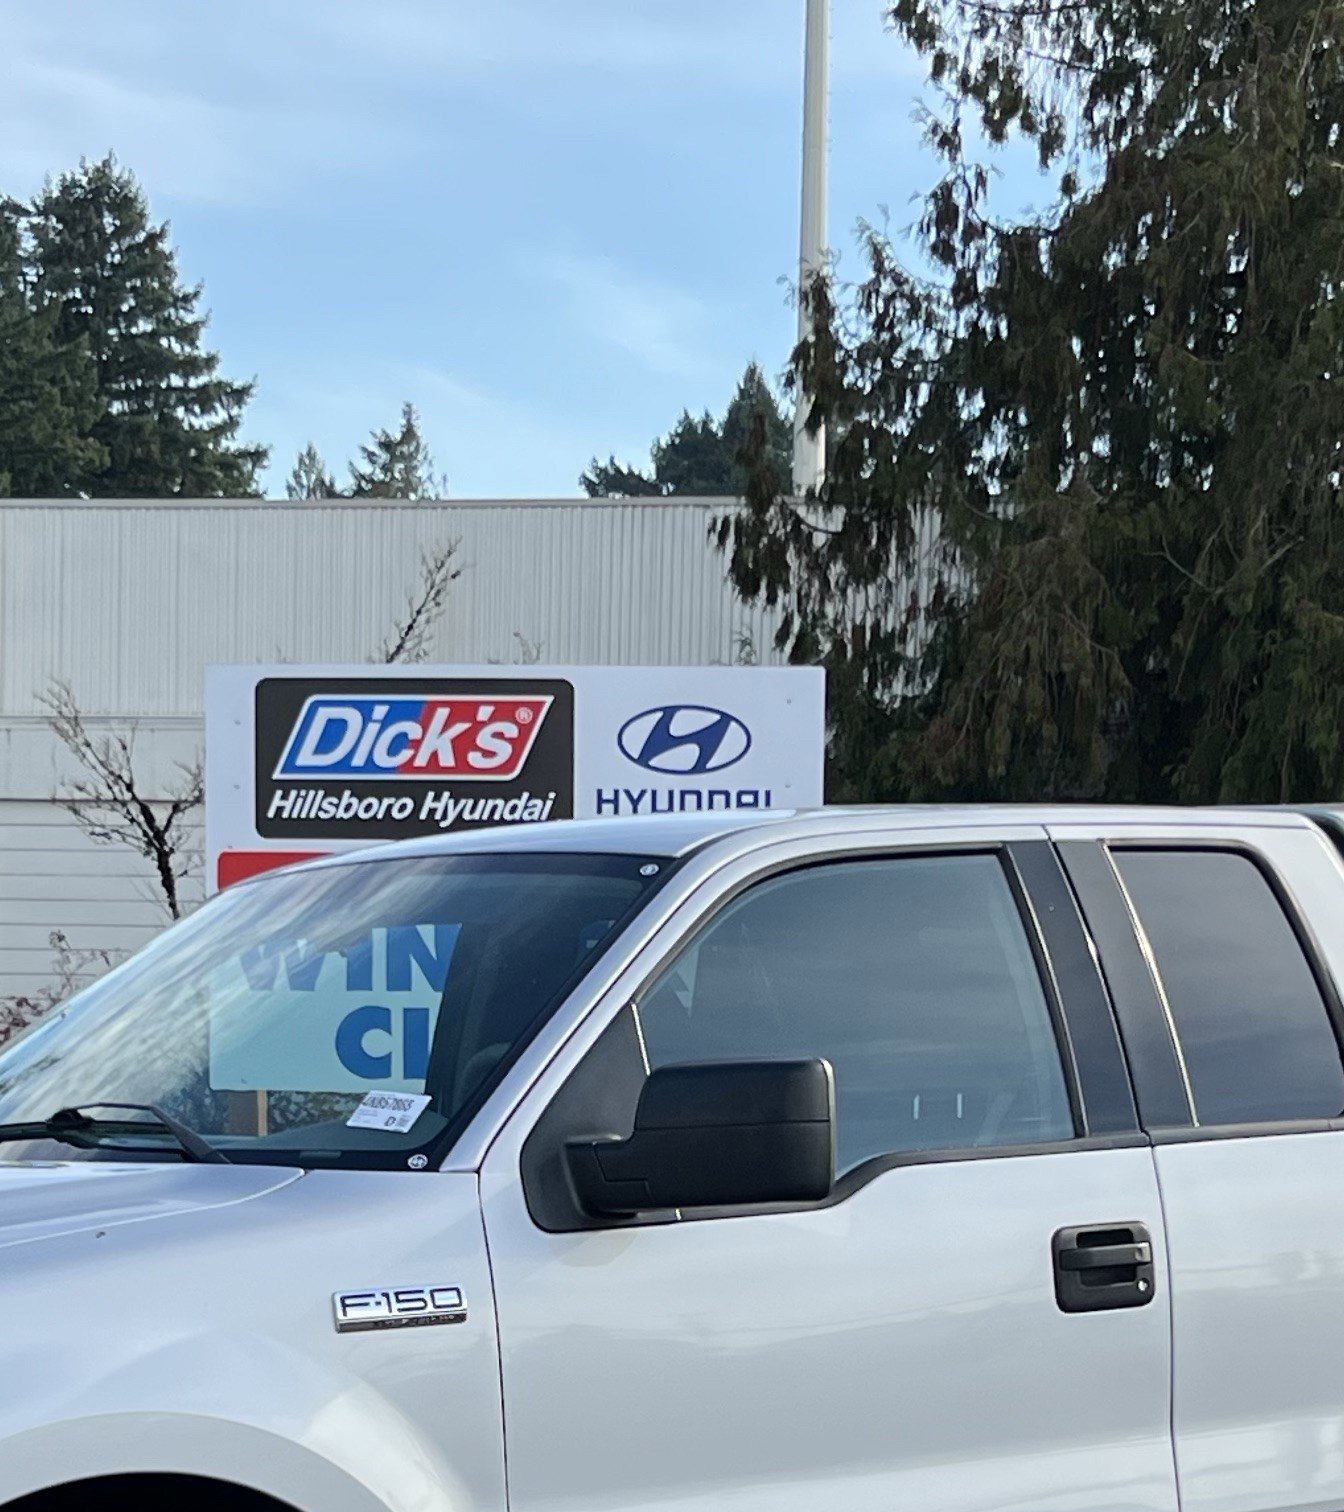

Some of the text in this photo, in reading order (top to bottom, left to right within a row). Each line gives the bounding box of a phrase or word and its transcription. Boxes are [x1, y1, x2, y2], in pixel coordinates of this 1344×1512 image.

[294, 702, 521, 770] Dick's
[266, 789, 557, 829] Hillsboro Hyundai
[597, 788, 772, 815] HYUNDAI
[340, 1286, 464, 1318] F-150
